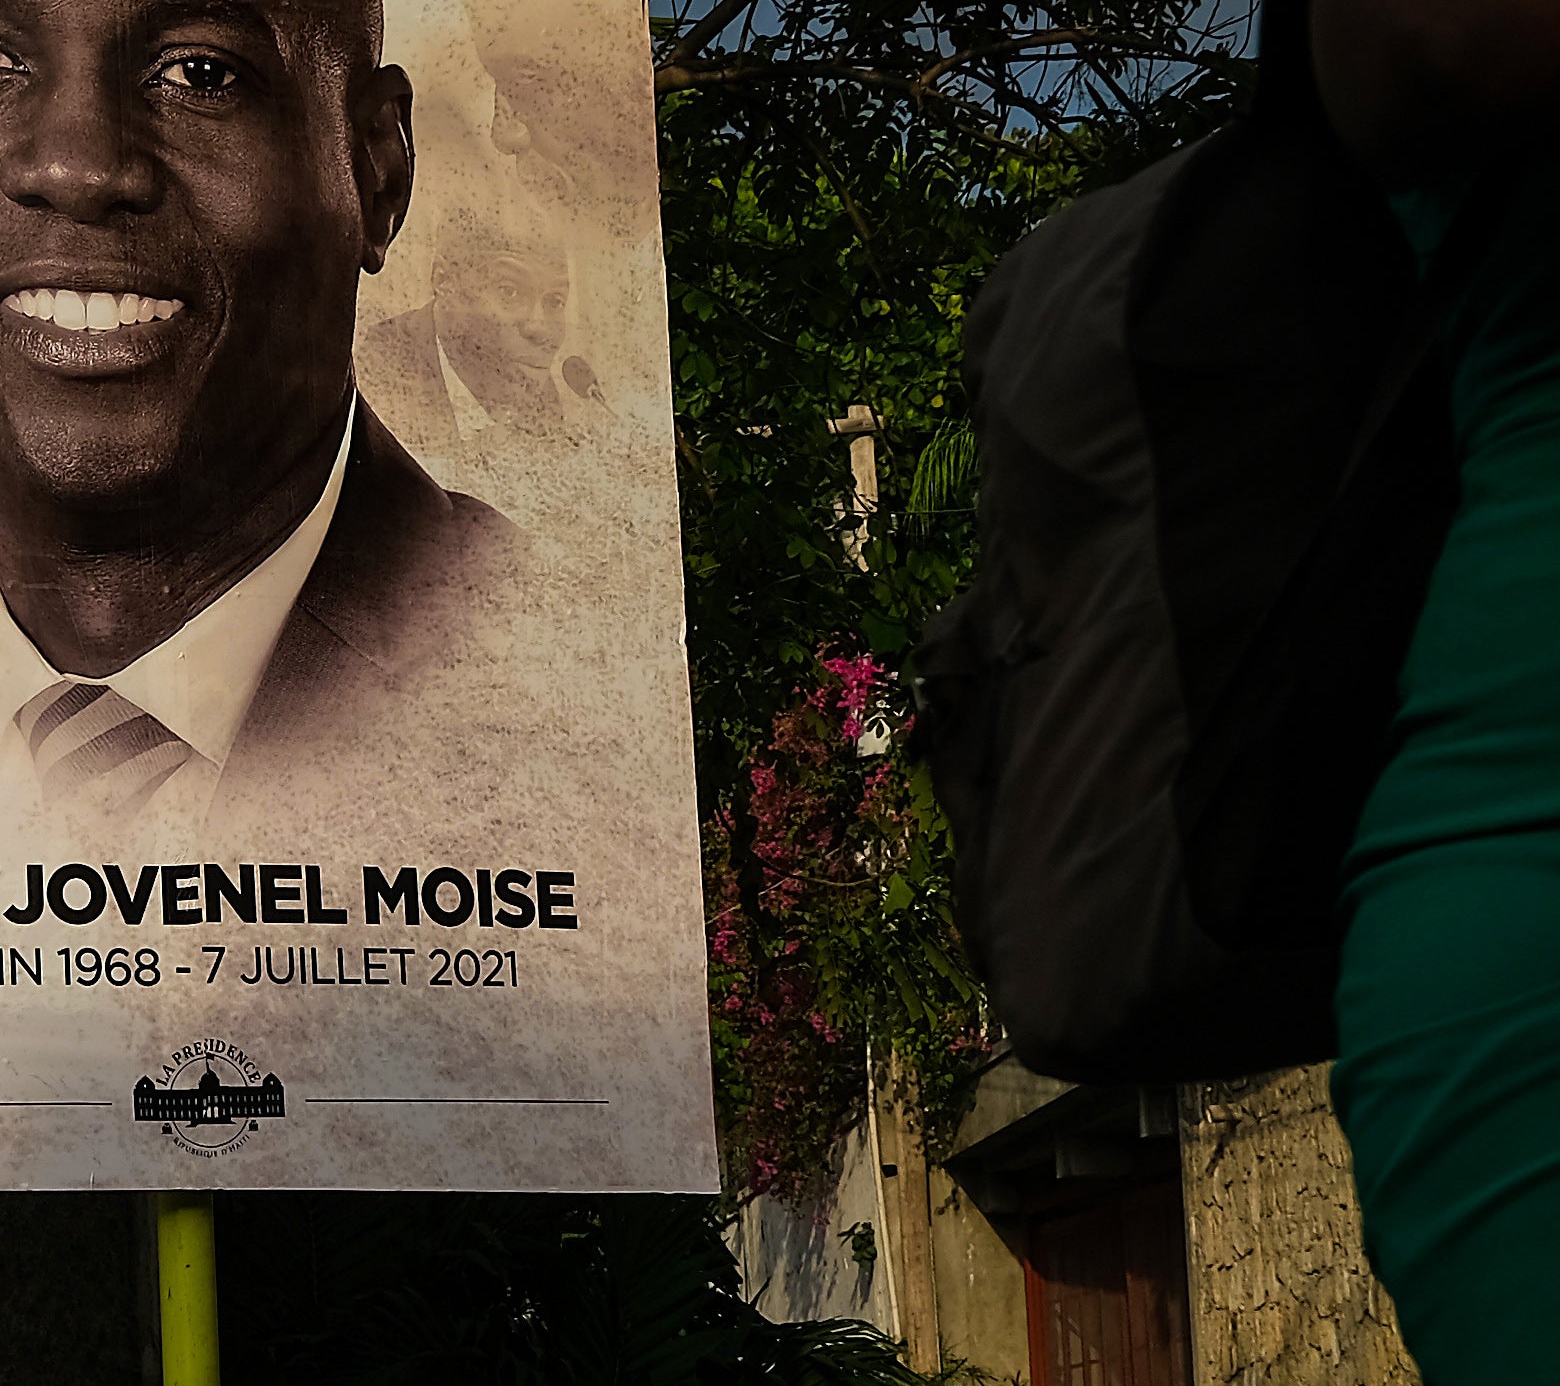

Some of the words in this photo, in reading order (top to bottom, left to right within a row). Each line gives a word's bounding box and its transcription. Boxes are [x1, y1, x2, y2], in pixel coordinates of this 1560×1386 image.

[2, 863, 348, 926] JOVENEL
[362, 865, 578, 929] MOISE
[57, 946, 162, 987] 1968
[201, 945, 227, 984] 7
[240, 946, 416, 985] JUILLET
[428, 948, 519, 988] 2021
[156, 1064, 176, 1086] LA
